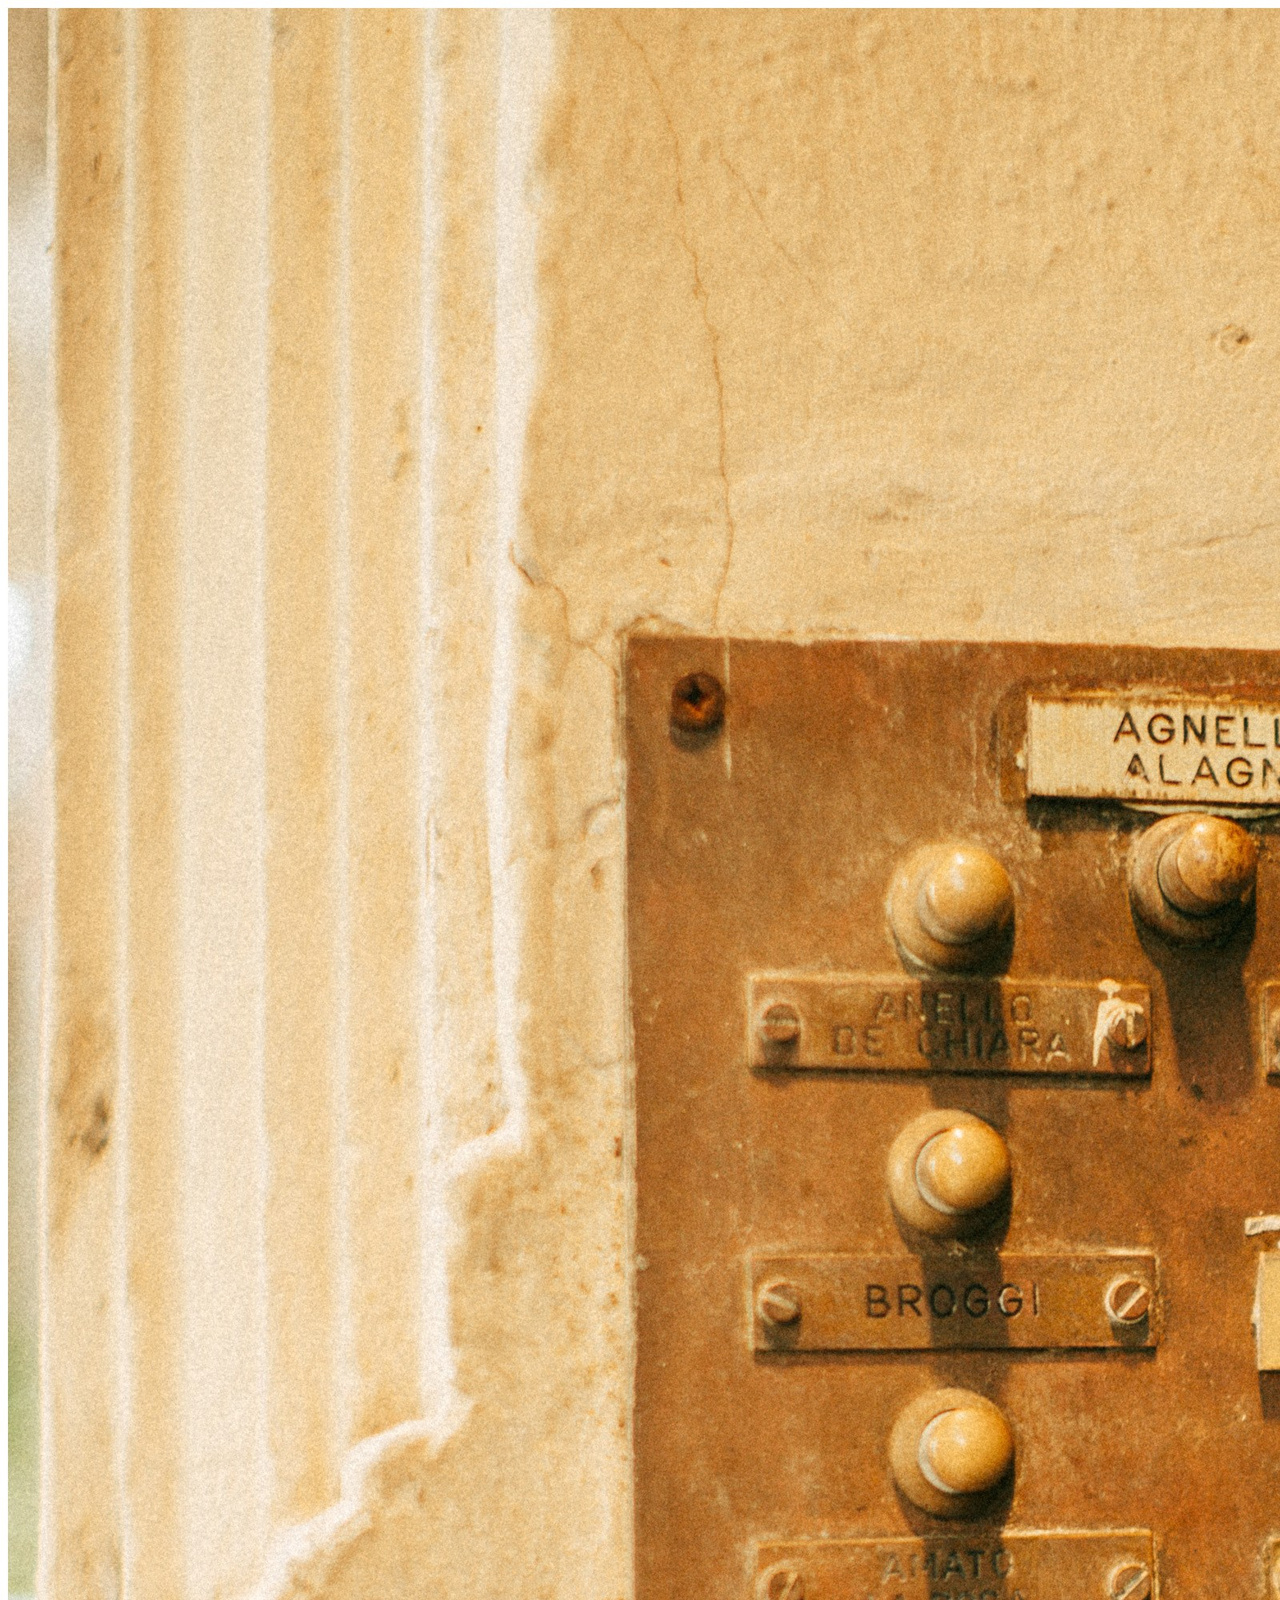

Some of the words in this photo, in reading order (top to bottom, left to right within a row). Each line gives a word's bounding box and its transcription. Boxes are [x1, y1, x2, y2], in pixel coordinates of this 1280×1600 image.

[874, 991, 1033, 1025] ANELLO
[834, 1025, 886, 1058] DE
[917, 1026, 1072, 1065] CHIARA
[865, 1281, 1040, 1319] BROGGI
[881, 1549, 1015, 1585] AMATO
